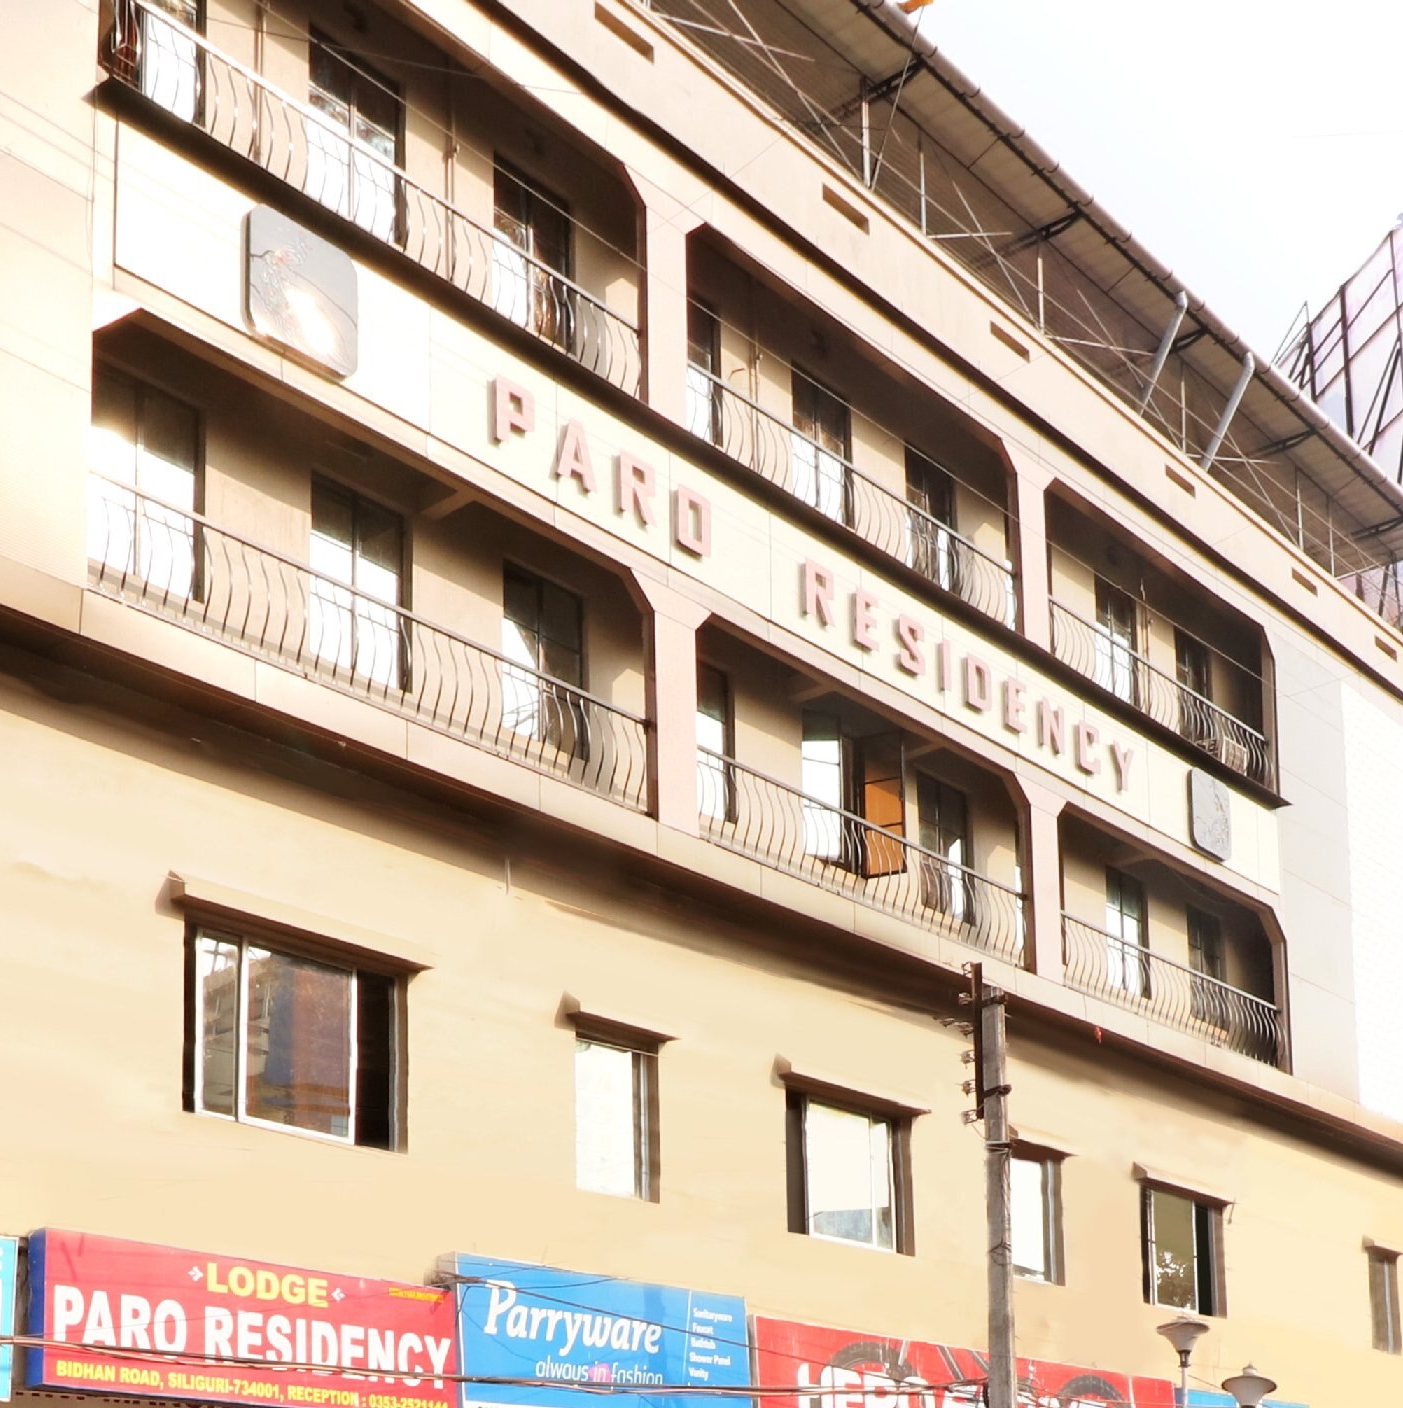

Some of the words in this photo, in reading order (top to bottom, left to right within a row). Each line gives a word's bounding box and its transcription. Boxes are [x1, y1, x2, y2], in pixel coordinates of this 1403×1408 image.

[488, 374, 713, 559] PARO
[799, 560, 1137, 793] RESIDENCY
[206, 1262, 329, 1308] LODGE
[484, 1279, 662, 1357] Parryware
[52, 1284, 187, 1361] PARO
[203, 1305, 451, 1390] RESIDENCY
[56, 1360, 115, 1382] BIDHAN
[120, 1368, 164, 1391] ROAD,
[167, 1371, 284, 1402] SILIGURI-734001,
[287, 1384, 359, 1408] RECEPTION
